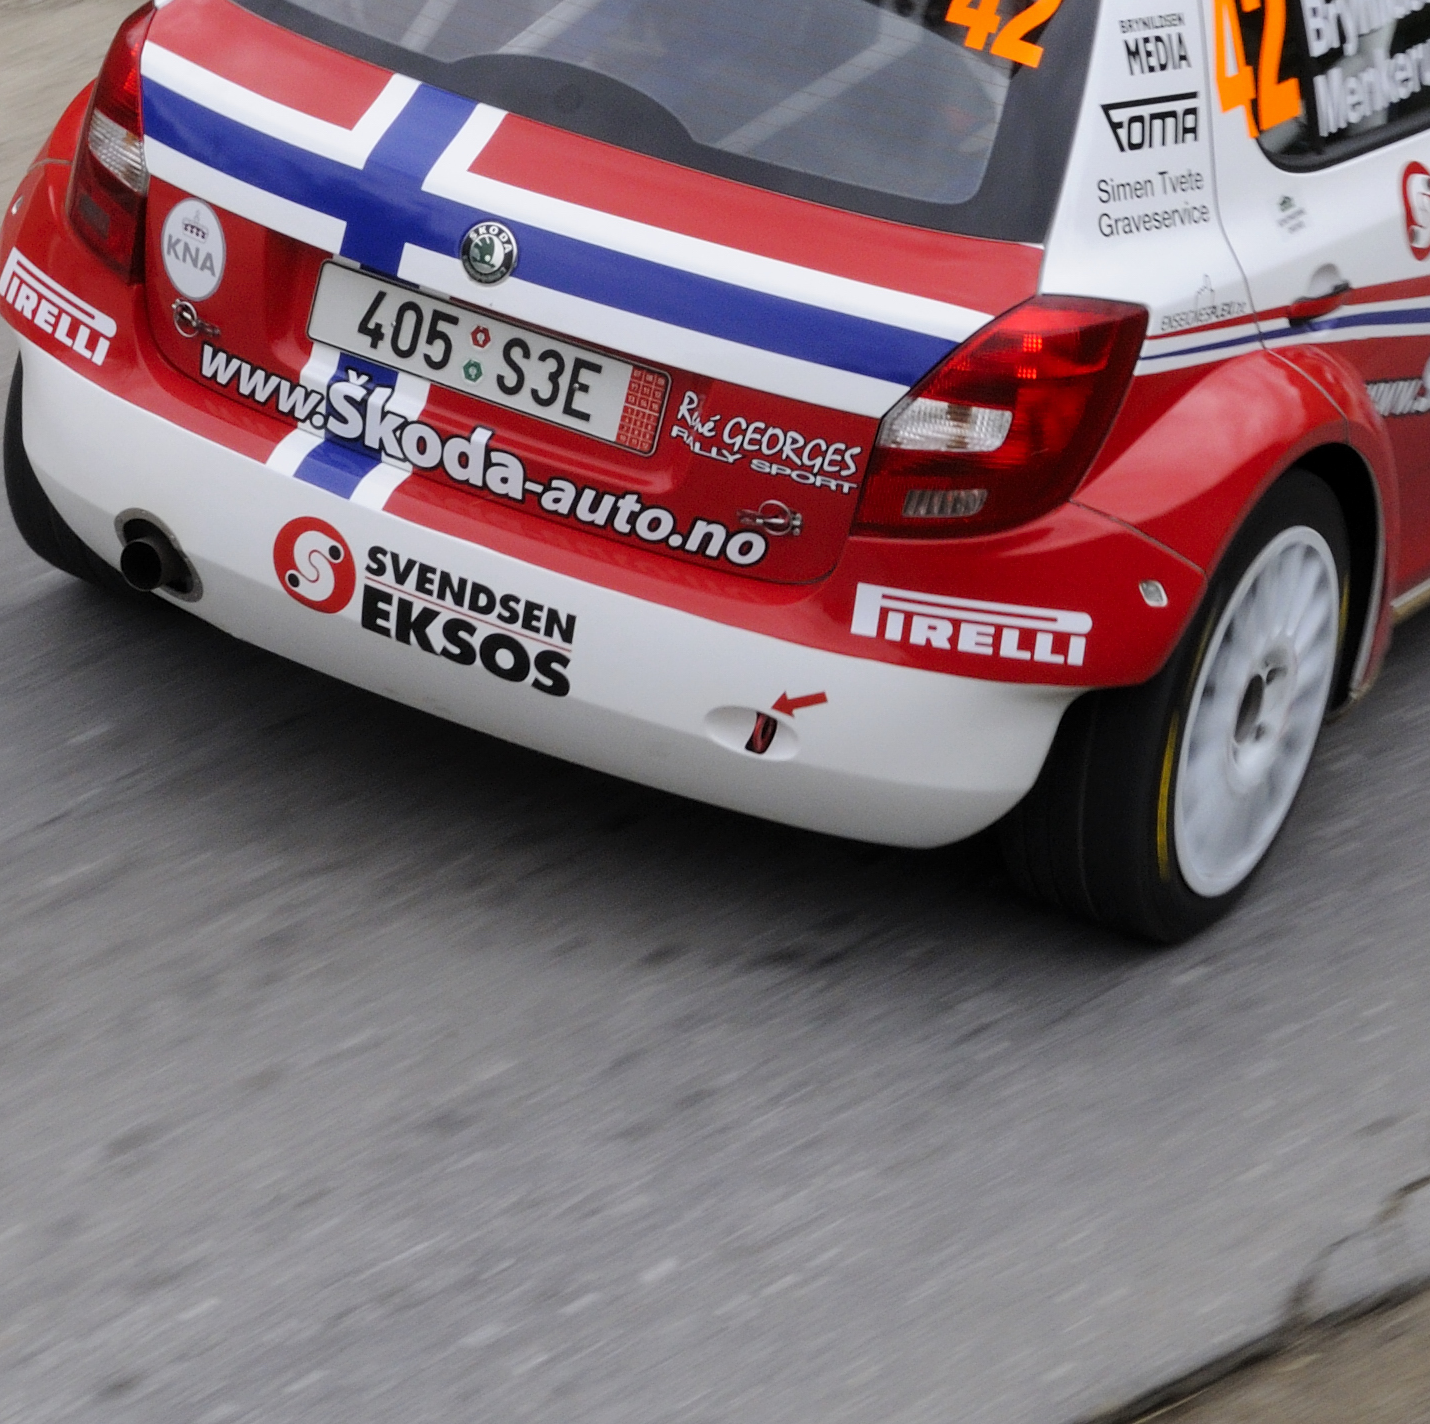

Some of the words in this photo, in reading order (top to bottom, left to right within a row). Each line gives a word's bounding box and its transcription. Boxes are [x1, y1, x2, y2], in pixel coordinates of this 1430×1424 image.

[1118, 11, 1186, 35] BRYNILDSEN
[1123, 31, 1193, 76] MEDIA
[1097, 178, 1154, 206] Simen
[1157, 169, 1205, 196] Tvete
[1098, 201, 1211, 239] Graveservice
[166, 234, 217, 277] KNA
[357, 289, 460, 371] 405
[496, 336, 603, 423] S3E
[199, 343, 768, 568] www.Škoda-auto.no
[670, 425, 743, 464] RALLY
[749, 457, 858, 494] SPORT
[721, 416, 862, 476] GEORGES
[364, 544, 577, 645] SVENDSEN
[851, 582, 1093, 666] PIRELLI
[360, 583, 571, 699] EKSOS
